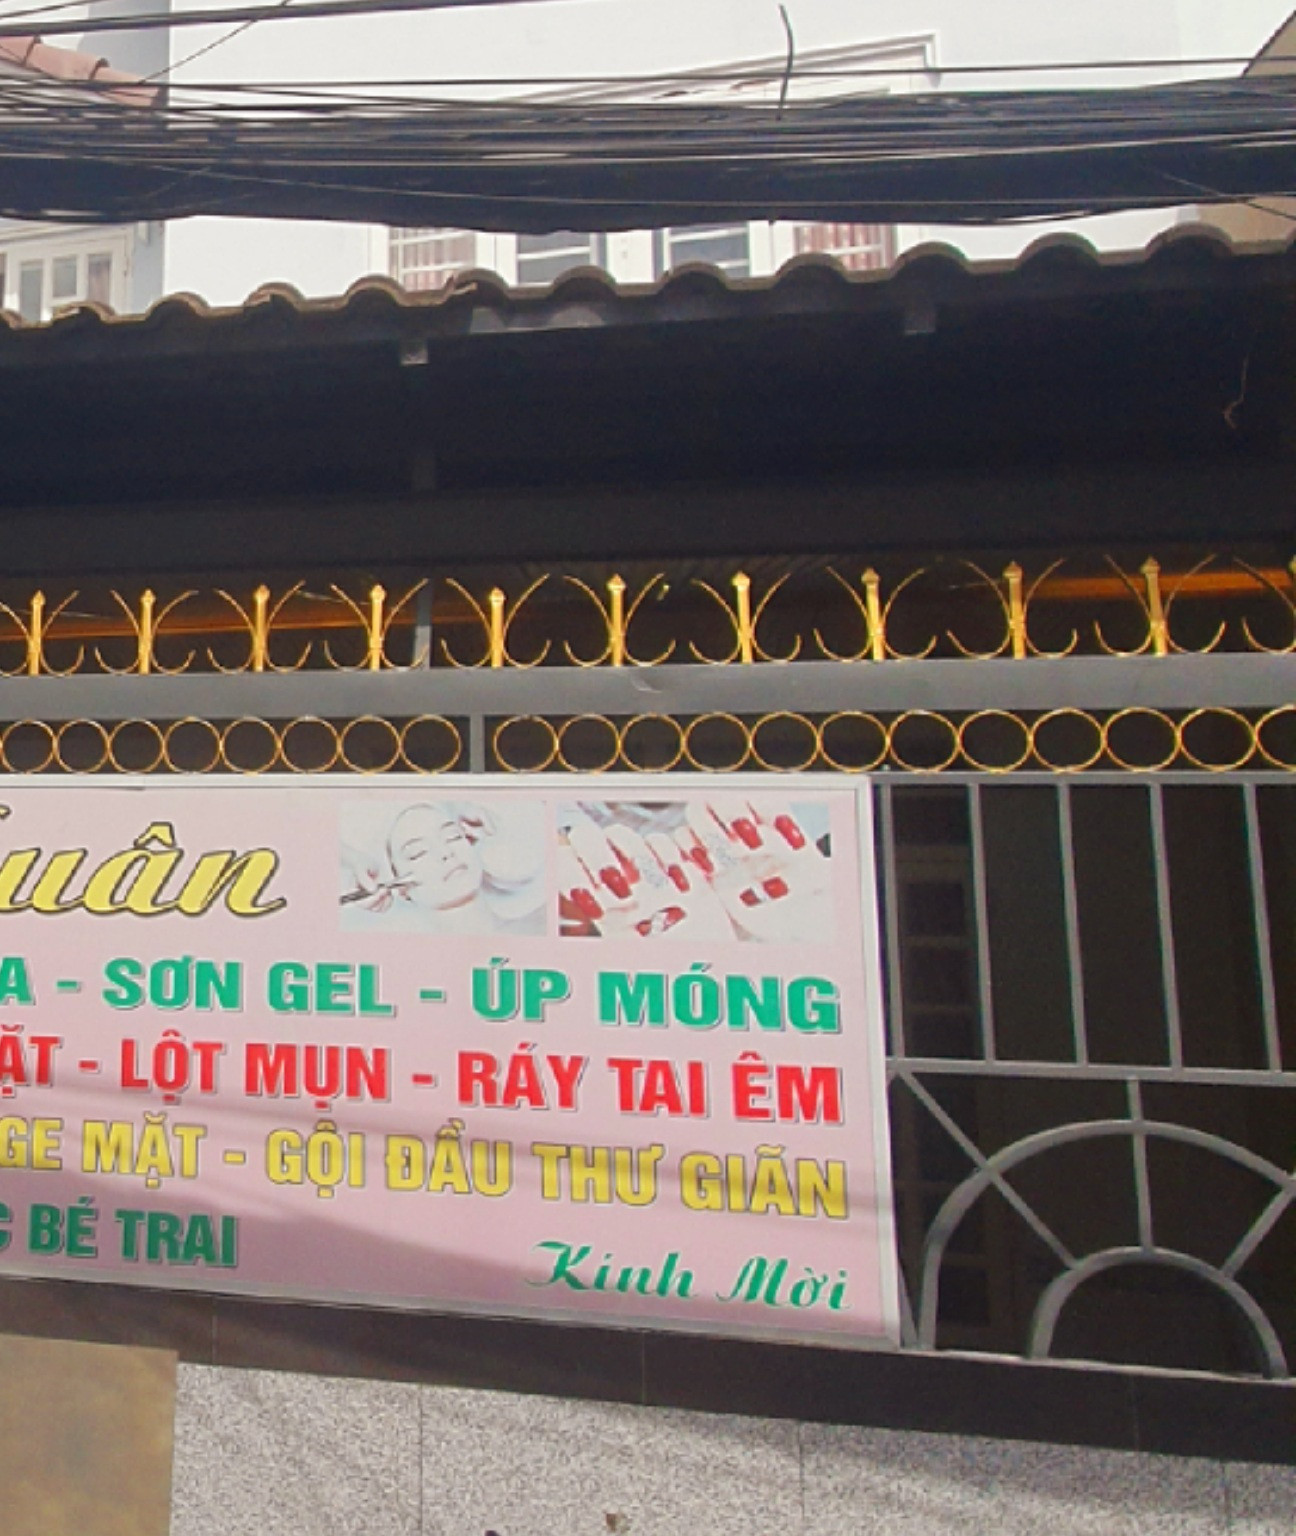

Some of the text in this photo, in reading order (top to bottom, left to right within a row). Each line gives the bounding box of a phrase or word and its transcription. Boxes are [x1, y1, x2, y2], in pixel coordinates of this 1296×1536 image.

[102, 956, 244, 1012] SƠN
[267, 960, 396, 1017] GEL
[471, 957, 571, 1023] ÚP
[598, 962, 843, 1034] MÓNG
[120, 1029, 226, 1104] LỘT
[245, 1042, 391, 1112] MỤN
[457, 1042, 588, 1112] RÁY
[606, 1058, 709, 1117] TAI
[731, 1050, 845, 1125] ÊM
[82, 1111, 207, 1189] MẶT
[266, 1119, 366, 1199] GỘI
[385, 1117, 512, 1197] ĐẦU
[531, 1142, 664, 1206] THƯ
[679, 1144, 851, 1221] GIÃN
[27, 1196, 98, 1257] BÉ
[114, 1208, 240, 1268] TRAI
[715, 1255, 851, 1310] Mời
